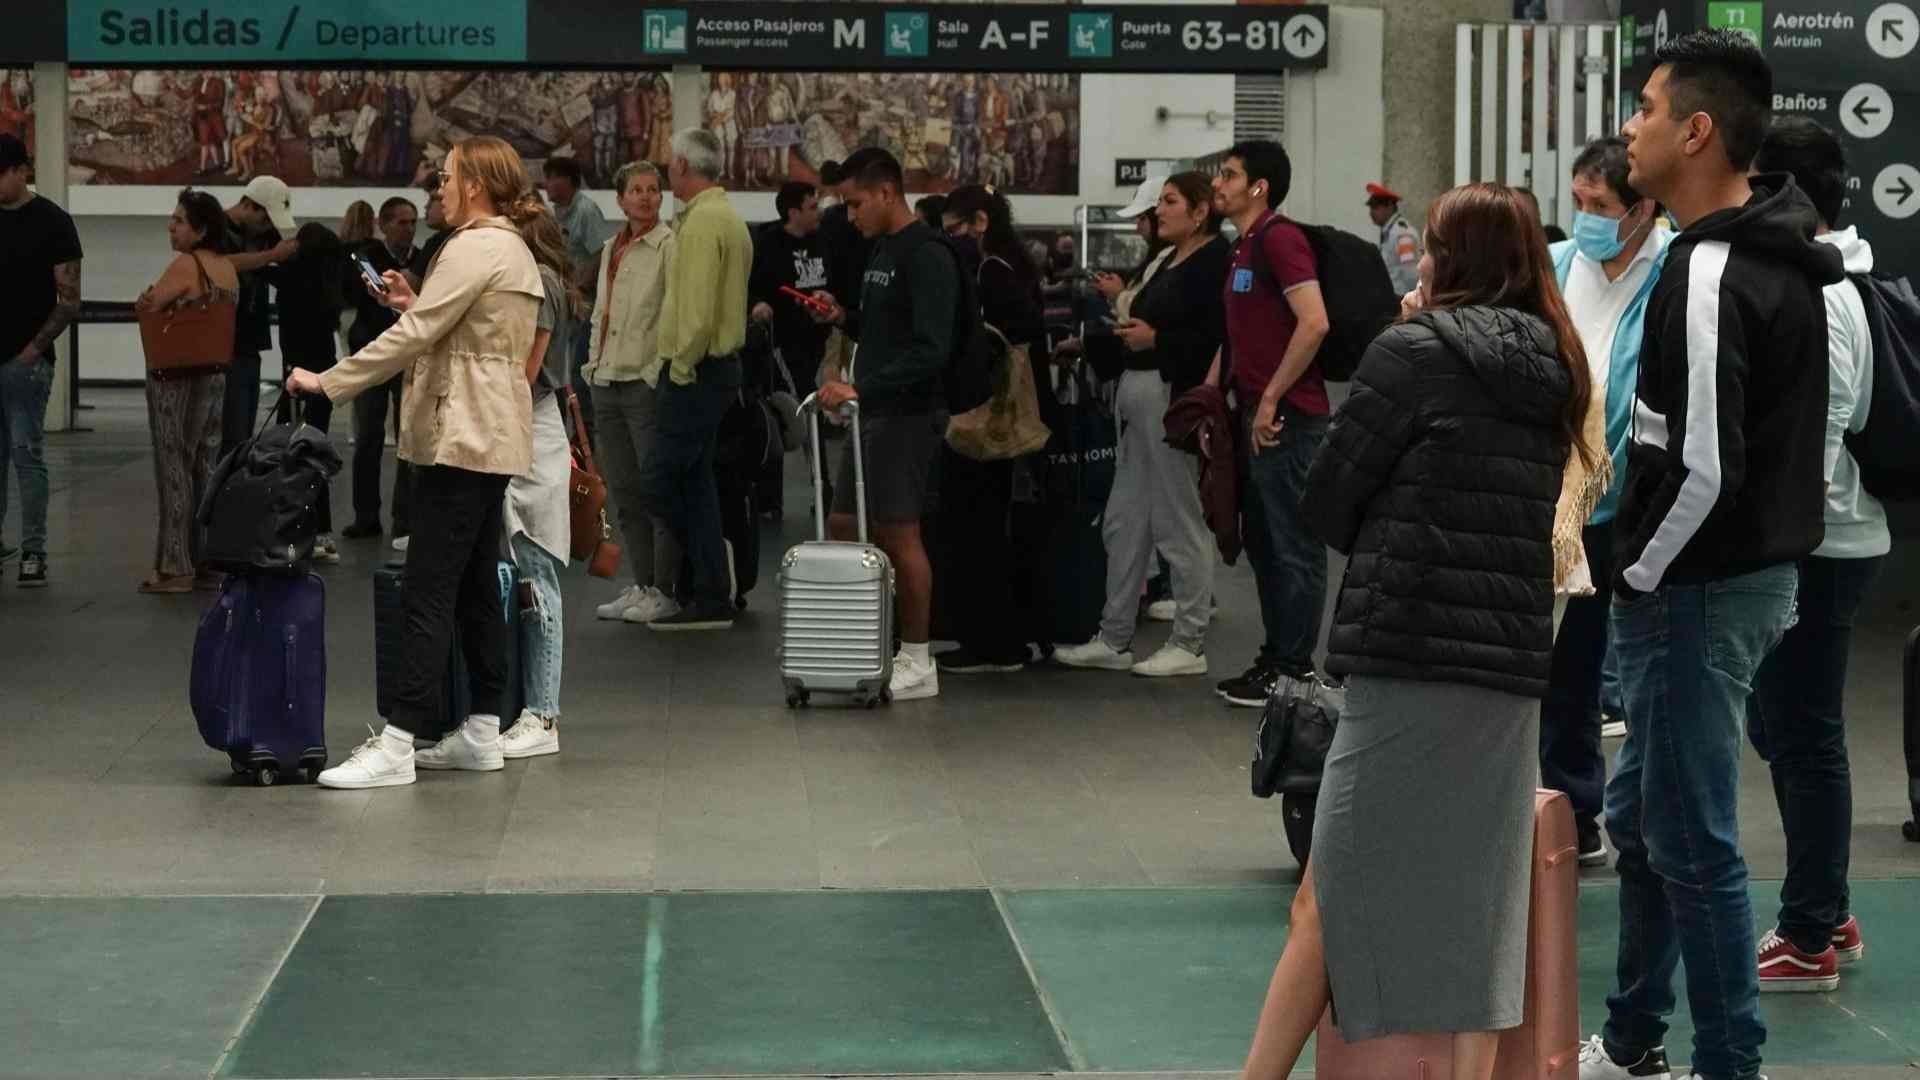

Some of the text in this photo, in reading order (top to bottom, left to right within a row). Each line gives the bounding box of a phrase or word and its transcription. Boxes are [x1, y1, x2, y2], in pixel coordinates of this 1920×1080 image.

[1726, 8, 1745, 25] T1
[1773, 12, 1854, 29] Aerotrén
[100, 5, 497, 51] Salidas / Departures
[696, 18, 825, 35] Acceso Pasajeros
[833, 19, 866, 48] M
[937, 21, 969, 34] Sala
[1122, 21, 1171, 35] Puerta
[1182, 21, 1280, 50] 63-81
[1774, 35, 1822, 48] Airtrain
[1772, 93, 1827, 111] Baños
